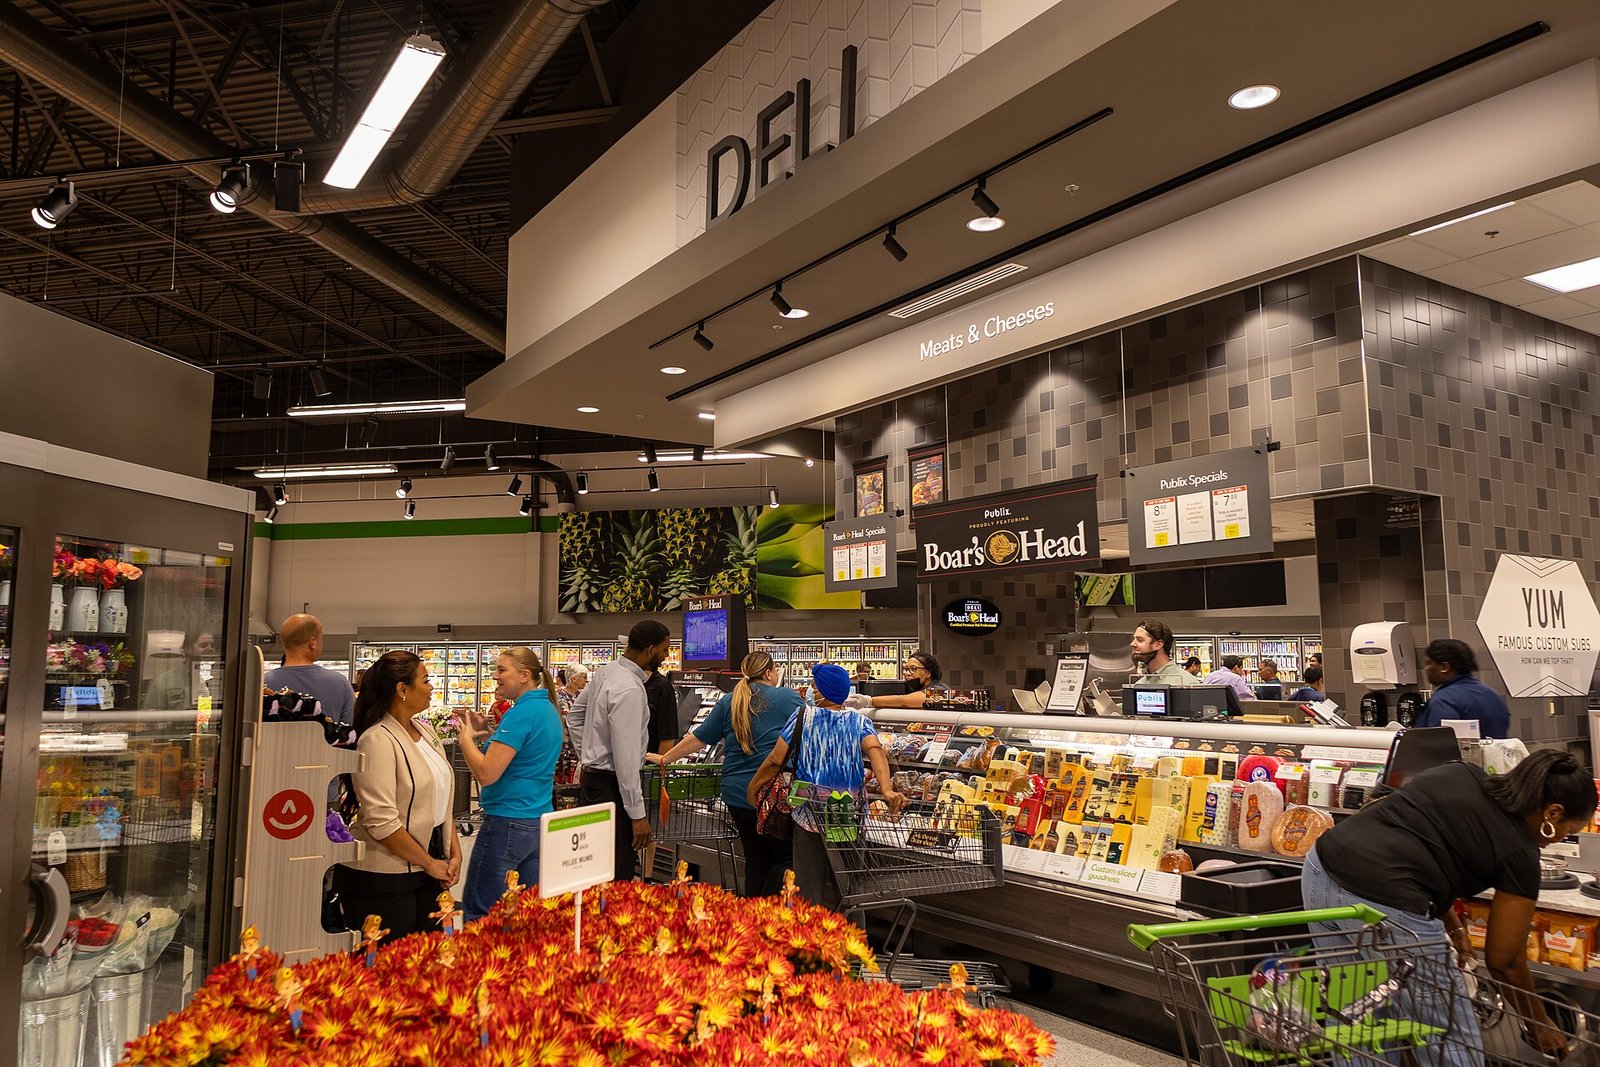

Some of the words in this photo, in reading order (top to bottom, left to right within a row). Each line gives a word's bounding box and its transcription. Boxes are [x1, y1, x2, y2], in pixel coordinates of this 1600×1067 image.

[706, 44, 857, 232] DELI
[920, 333, 963, 361] Meats
[967, 324, 980, 345] &
[984, 301, 1055, 338] Cheeses
[1160, 477, 1187, 490] Publix
[1189, 470, 1228, 487] Specials
[969, 521, 994, 529] PROUDLY
[996, 516, 1030, 525] FEATURING
[865, 526, 887, 538] Specials
[923, 535, 985, 572] Boar's
[1018, 520, 1087, 561] Head
[688, 600, 703, 611] Boar's
[708, 598, 722, 609] Head
[1522, 587, 1566, 629] YUM
[947, 612, 970, 622] Boar's
[979, 612, 999, 623] Head
[1498, 635, 1533, 650] FAMOUS
[1537, 637, 1568, 651] CUSTOM
[1571, 638, 1591, 651] SUBS
[1521, 657, 1532, 665] HOW
[1533, 657, 1542, 665] CAN
[1543, 657, 1550, 665] WE
[1551, 657, 1560, 665] TOP
[562, 857, 578, 867] PELEE
[1090, 863, 1138, 879] Custom-sliced
